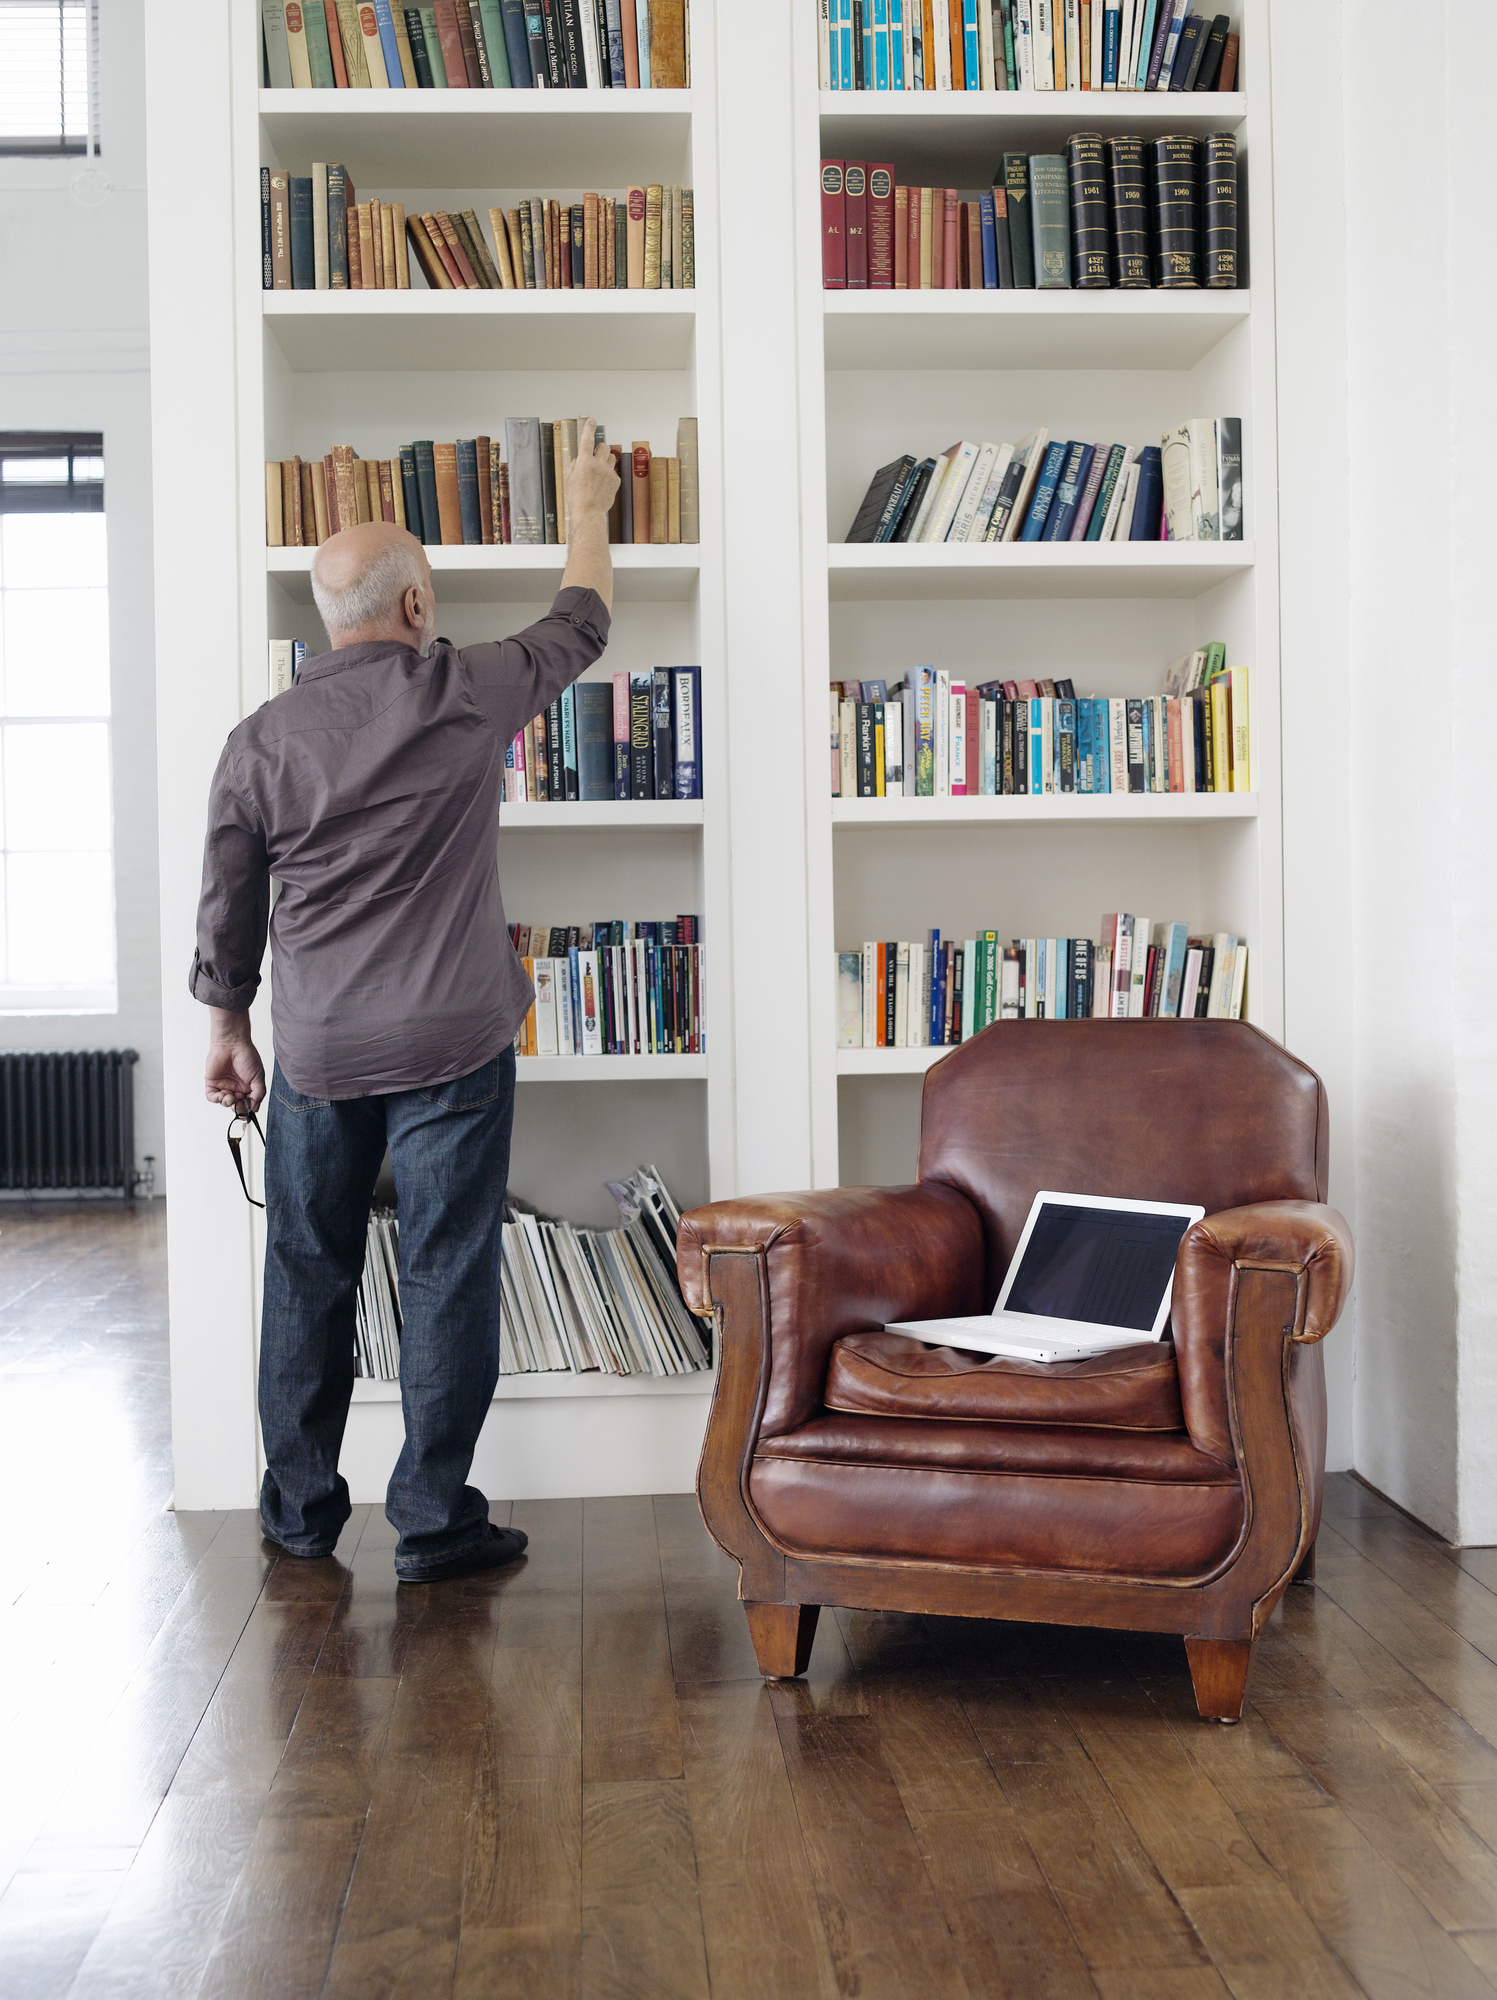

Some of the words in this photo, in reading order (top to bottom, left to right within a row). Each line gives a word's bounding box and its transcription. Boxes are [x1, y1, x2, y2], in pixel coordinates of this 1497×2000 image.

[473, 21, 482, 40] Clichy
[1161, 13, 1170, 32] ANIMAL
[546, 17, 556, 41] Portrait
[551, 55, 560, 85] Marriage
[568, 31, 576, 51] DARIO
[1155, 34, 1166, 55] PHILIP
[479, 50, 488, 65] Days
[570, 53, 578, 76] CECCHI
[1152, 55, 1160, 73] ROTH
[482, 67, 490, 82] Quiet
[1084, 187, 1100, 195] 1961
[1125, 191, 1140, 199] 1959
[1216, 186, 1233, 195] 1961
[1069, 444, 1085, 457] TINY
[1045, 447, 1060, 478] REGAN
[1053, 448, 1066, 475] DONALD
[1065, 457, 1081, 484] ROWLAND
[1111, 446, 1126, 481] PLACIDO
[898, 463, 912, 483] Jesse
[1120, 465, 1131, 481] DAYS
[941, 459, 966, 509] SEYMOUR
[968, 462, 988, 507] ARCHANGEL
[881, 482, 905, 525] LIVERMORE
[1030, 485, 1047, 520] RECORD
[1043, 488, 1054, 504] FOR
[1101, 480, 1117, 518] DOMINGO
[1111, 483, 1125, 509] JENNIFER
[990, 505, 1004, 527] COHN
[1037, 505, 1049, 523] THE
[1057, 503, 1066, 519] TOM
[950, 517, 962, 541] ROBERT
[1104, 508, 1118, 540] PATERSON
[617, 676, 629, 704] Stolen
[679, 677, 691, 747] BORDEAUX
[861, 705, 870, 718] Ian
[920, 686, 932, 718] PETER
[563, 697, 571, 729] CHARLES
[617, 705, 628, 740] Marches
[631, 695, 651, 749] STALINGRAD
[1113, 709, 1124, 721] Spy
[861, 719, 871, 751] Rankin
[920, 721, 932, 741] KAY
[1096, 726, 1105, 741] David
[1113, 720, 1124, 741] Perfect
[955, 735, 963, 767] FRANCE
[1096, 744, 1105, 755] Tale
[1130, 723, 1144, 765] LABYRINTH
[1097, 783, 1106, 793] The
[1115, 775, 1125, 791] JOHN
[552, 929, 568, 955] NICCI
[1137, 929, 1145, 945] IAIN
[986, 942, 995, 955] The
[1075, 939, 1088, 957] ONE
[1119, 938, 1129, 971] RESTLESS
[1136, 946, 1144, 968] BANKS
[955, 954, 963, 970] SIMON
[986, 954, 994, 970] 2006
[1075, 957, 1087, 968] OF
[1075, 968, 1087, 980] US
[985, 986, 993, 1006] Course
[587, 1018, 595, 1031] DOG
[985, 1006, 993, 1026] Guide
[887, 1016, 895, 1040] RODDY
